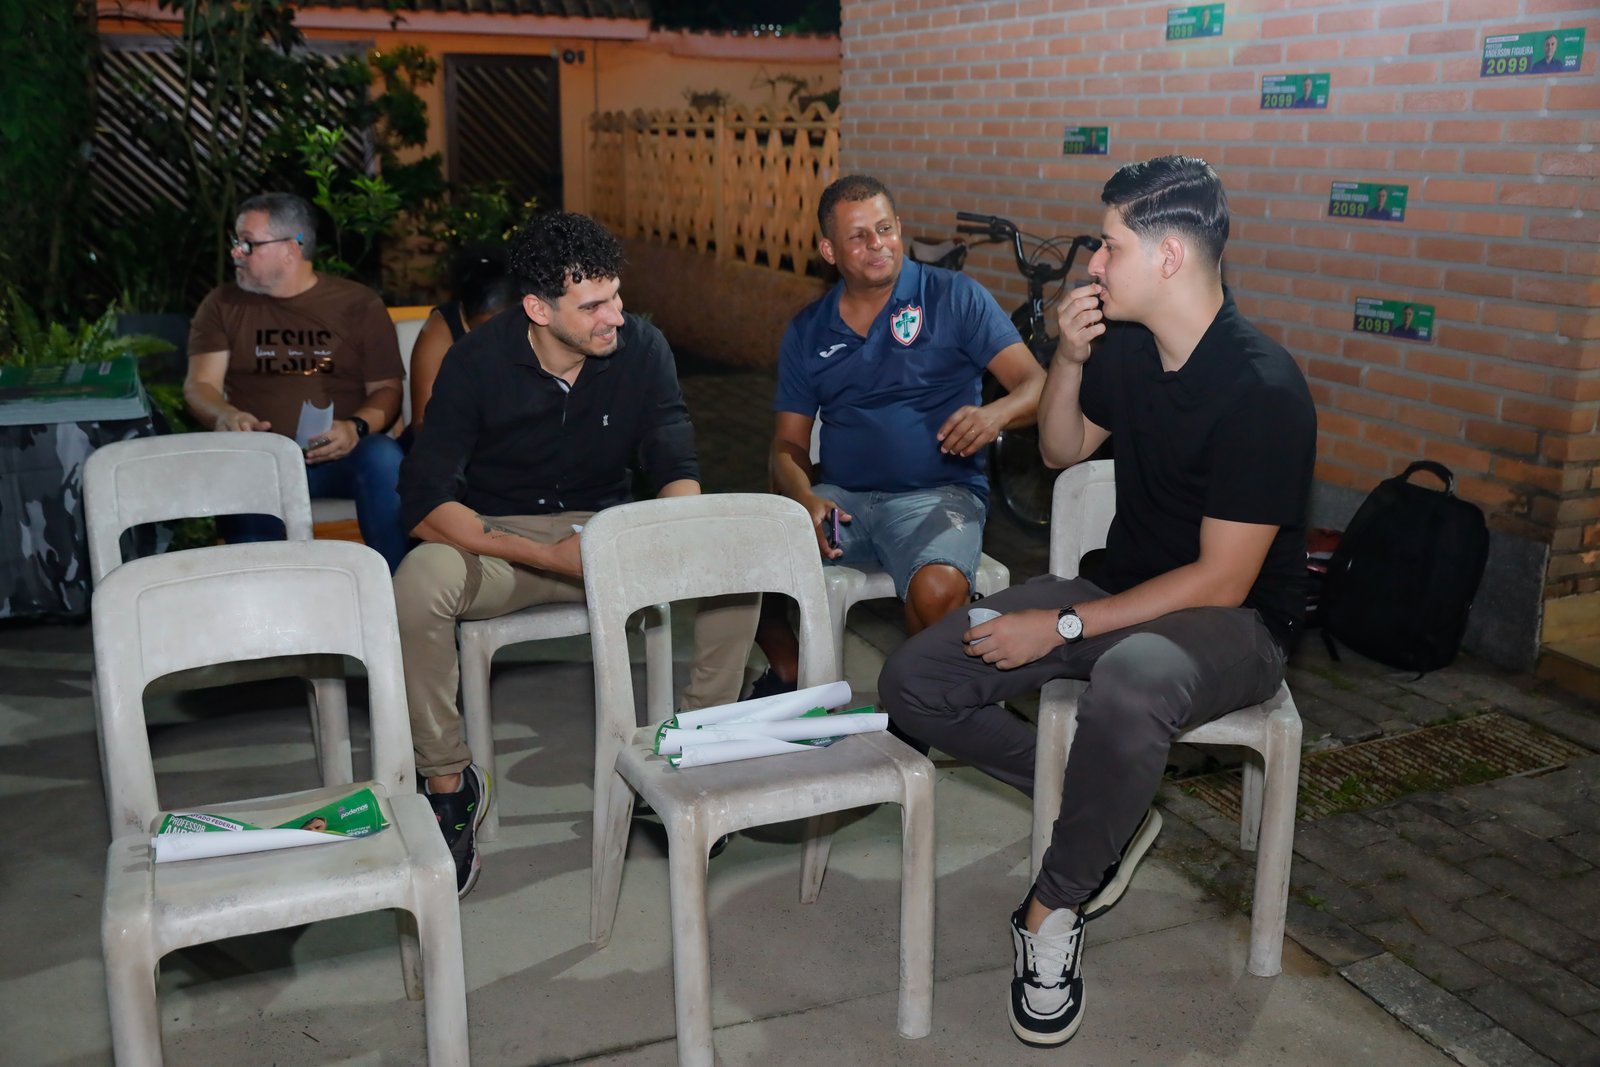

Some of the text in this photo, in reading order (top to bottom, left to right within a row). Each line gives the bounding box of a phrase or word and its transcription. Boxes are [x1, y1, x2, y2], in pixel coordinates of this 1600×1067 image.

[1485, 46, 1534, 58] ANDERSON FIGUEIRA
[1487, 56, 1528, 75] 2099
[1264, 94, 1293, 108] 2099
[1332, 202, 1365, 217] 2099
[1357, 316, 1390, 334] 2099
[340, 803, 369, 820] podemos
[168, 815, 206, 833] PROFESSOR
[211, 816, 238, 831] FEDERAL
